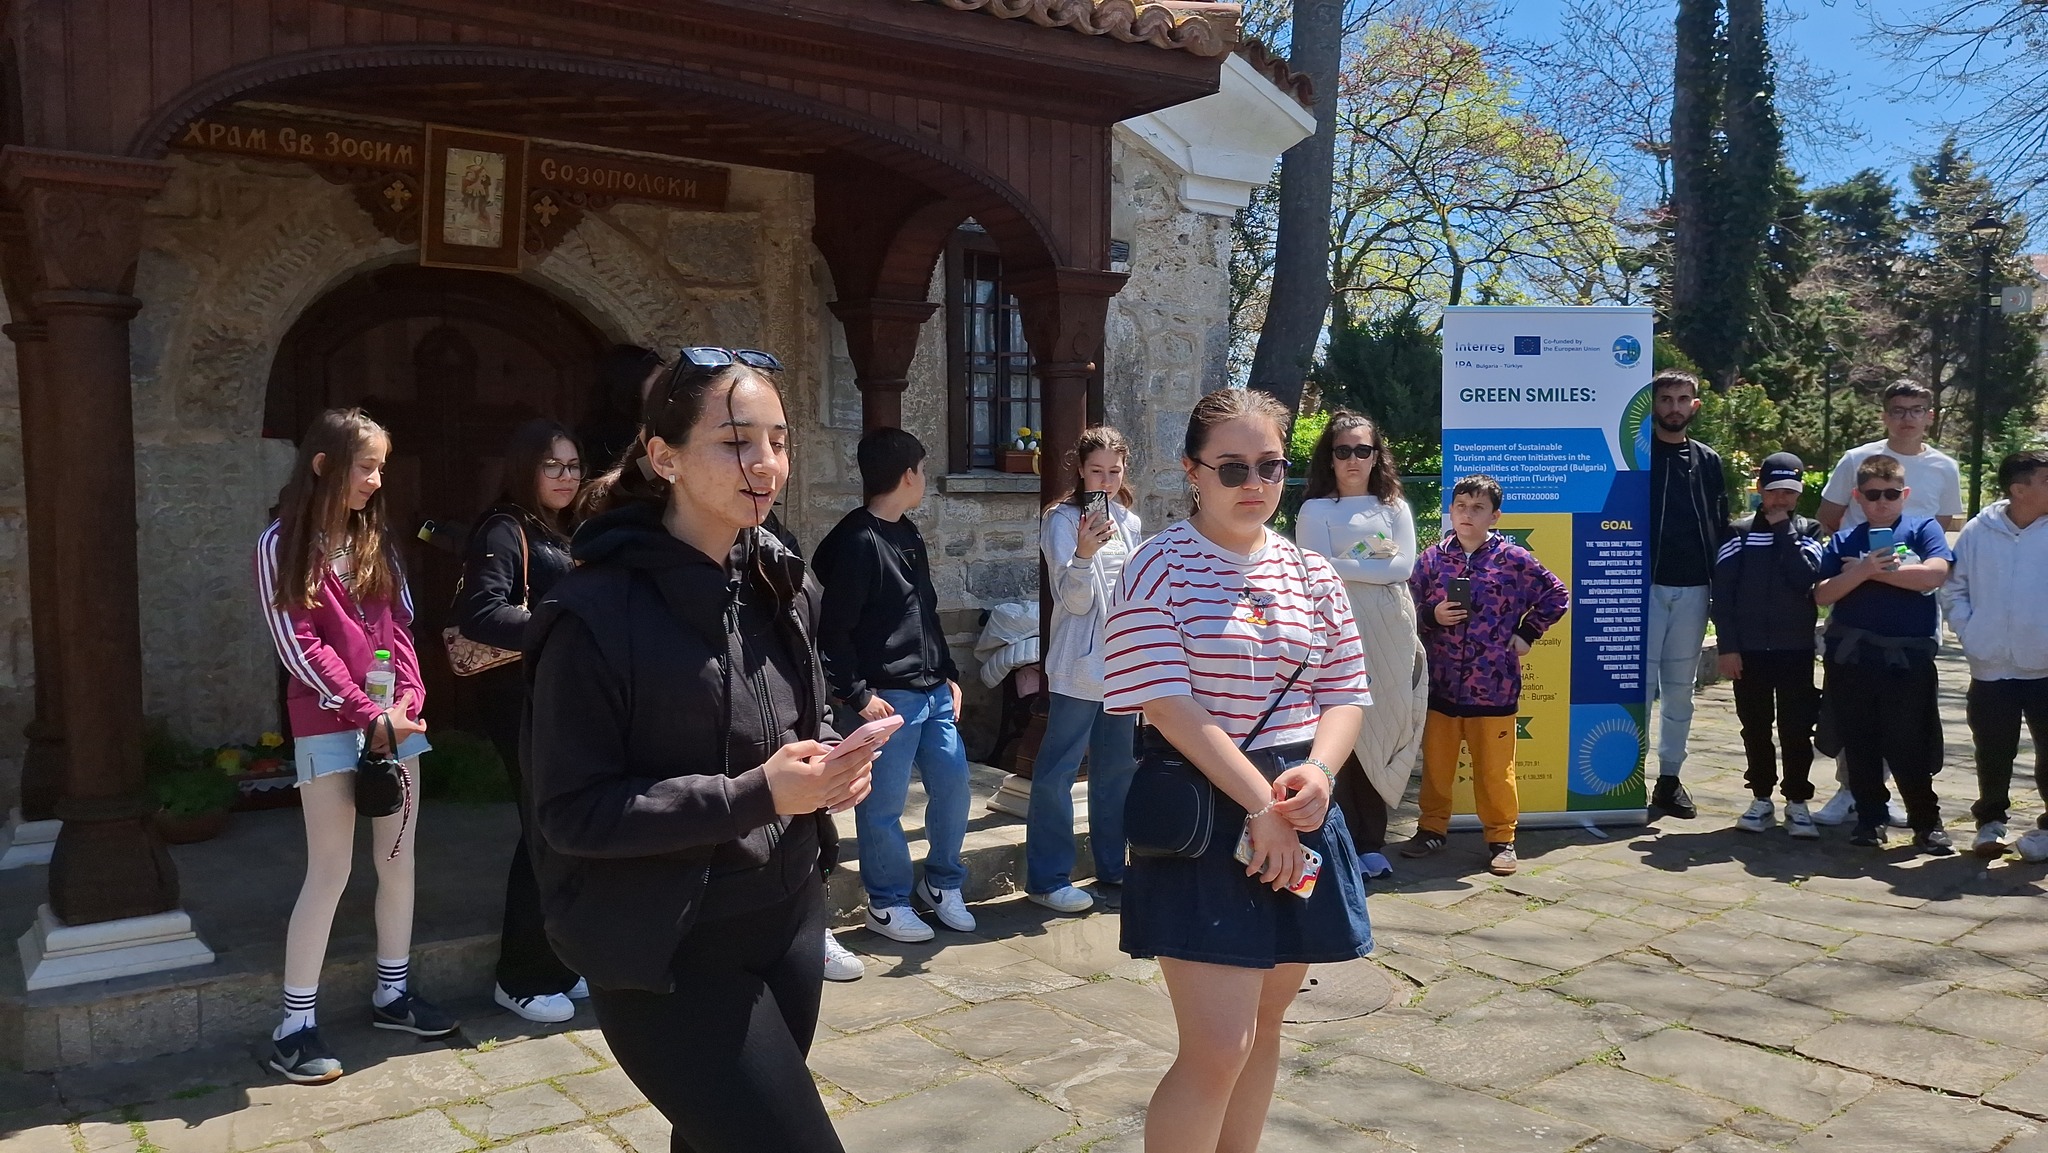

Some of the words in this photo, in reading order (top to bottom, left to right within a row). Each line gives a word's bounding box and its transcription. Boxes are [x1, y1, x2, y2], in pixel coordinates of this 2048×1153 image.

[1575, 338, 1582, 346] by
[1455, 342, 1505, 354] Interreg
[1455, 360, 1472, 369] IPA
[1460, 387, 1520, 403] GREEN
[1525, 387, 1596, 403] SMILES:
[1453, 443, 1507, 452] Development
[1508, 442, 1517, 451] of
[1518, 443, 1563, 451] Sustainable
[1453, 454, 1486, 462] Tourism
[1487, 454, 1501, 462] and
[1528, 453, 1567, 461] Initiatives
[1568, 453, 1576, 461] in
[1577, 453, 1591, 461] the
[1453, 464, 1509, 472] Municipalities
[1520, 464, 1568, 473] Topolovgrad
[1569, 463, 1607, 473] (Bulgaria)
[1506, 492, 1560, 500] BGTR0200080
[1600, 520, 1633, 530] GOAL
[1526, 663, 1533, 671] 3:
